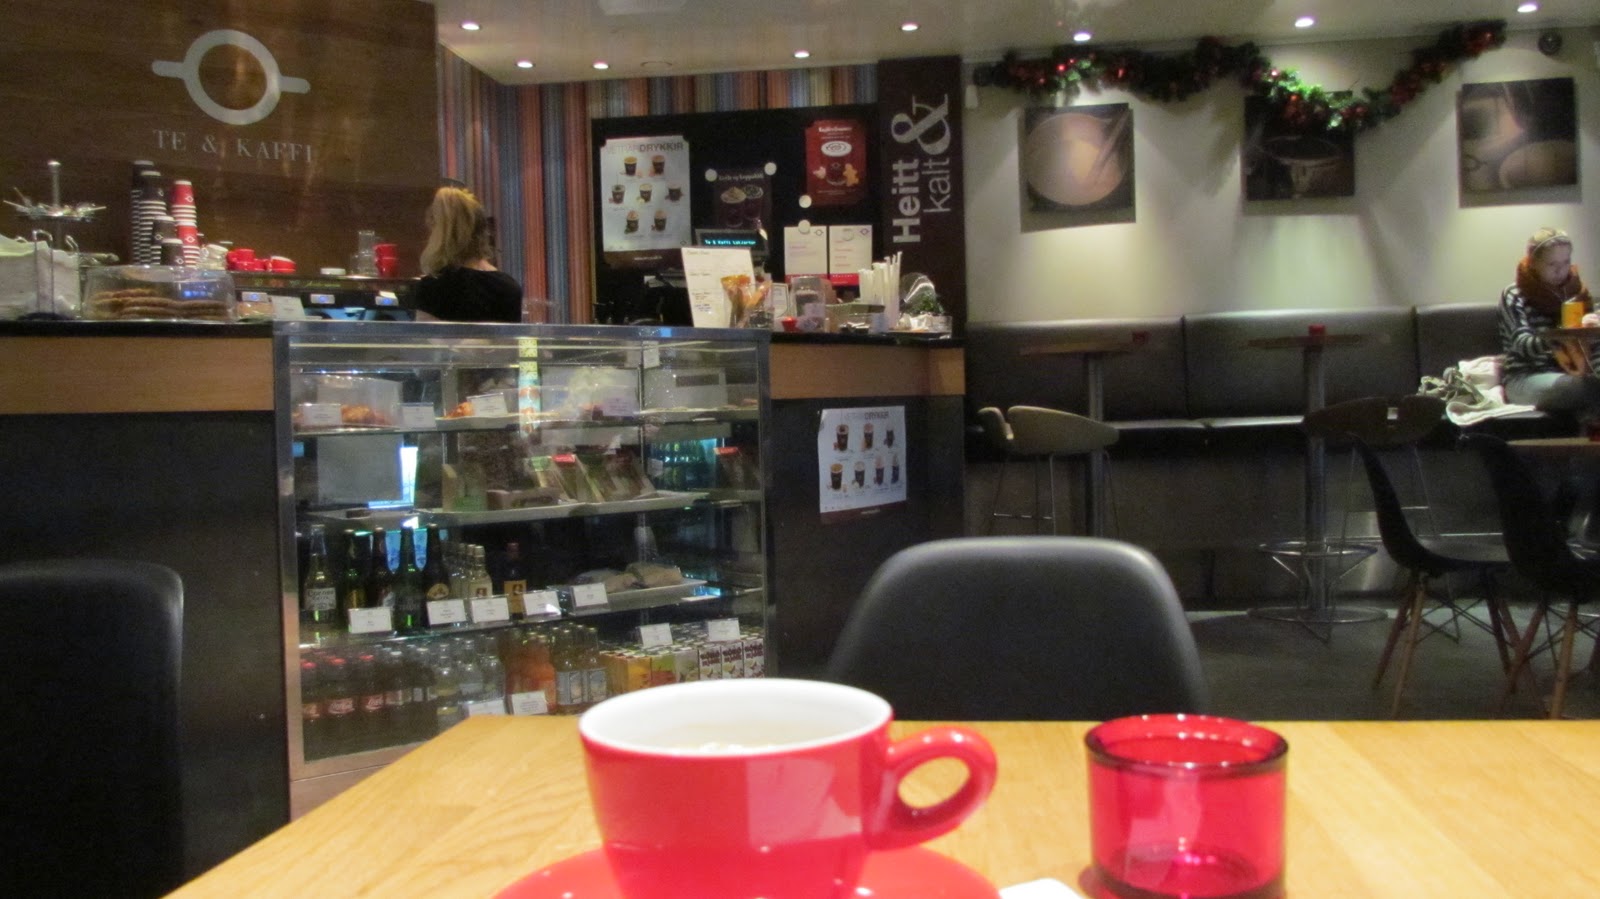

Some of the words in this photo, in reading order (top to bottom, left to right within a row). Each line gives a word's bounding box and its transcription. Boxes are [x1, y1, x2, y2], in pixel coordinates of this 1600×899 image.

[153, 129, 186, 150] TE
[202, 134, 217, 153] &
[237, 138, 313, 162] KAFFI
[891, 93, 951, 155] &
[891, 158, 920, 243] Heitt
[921, 157, 951, 213] kalt
